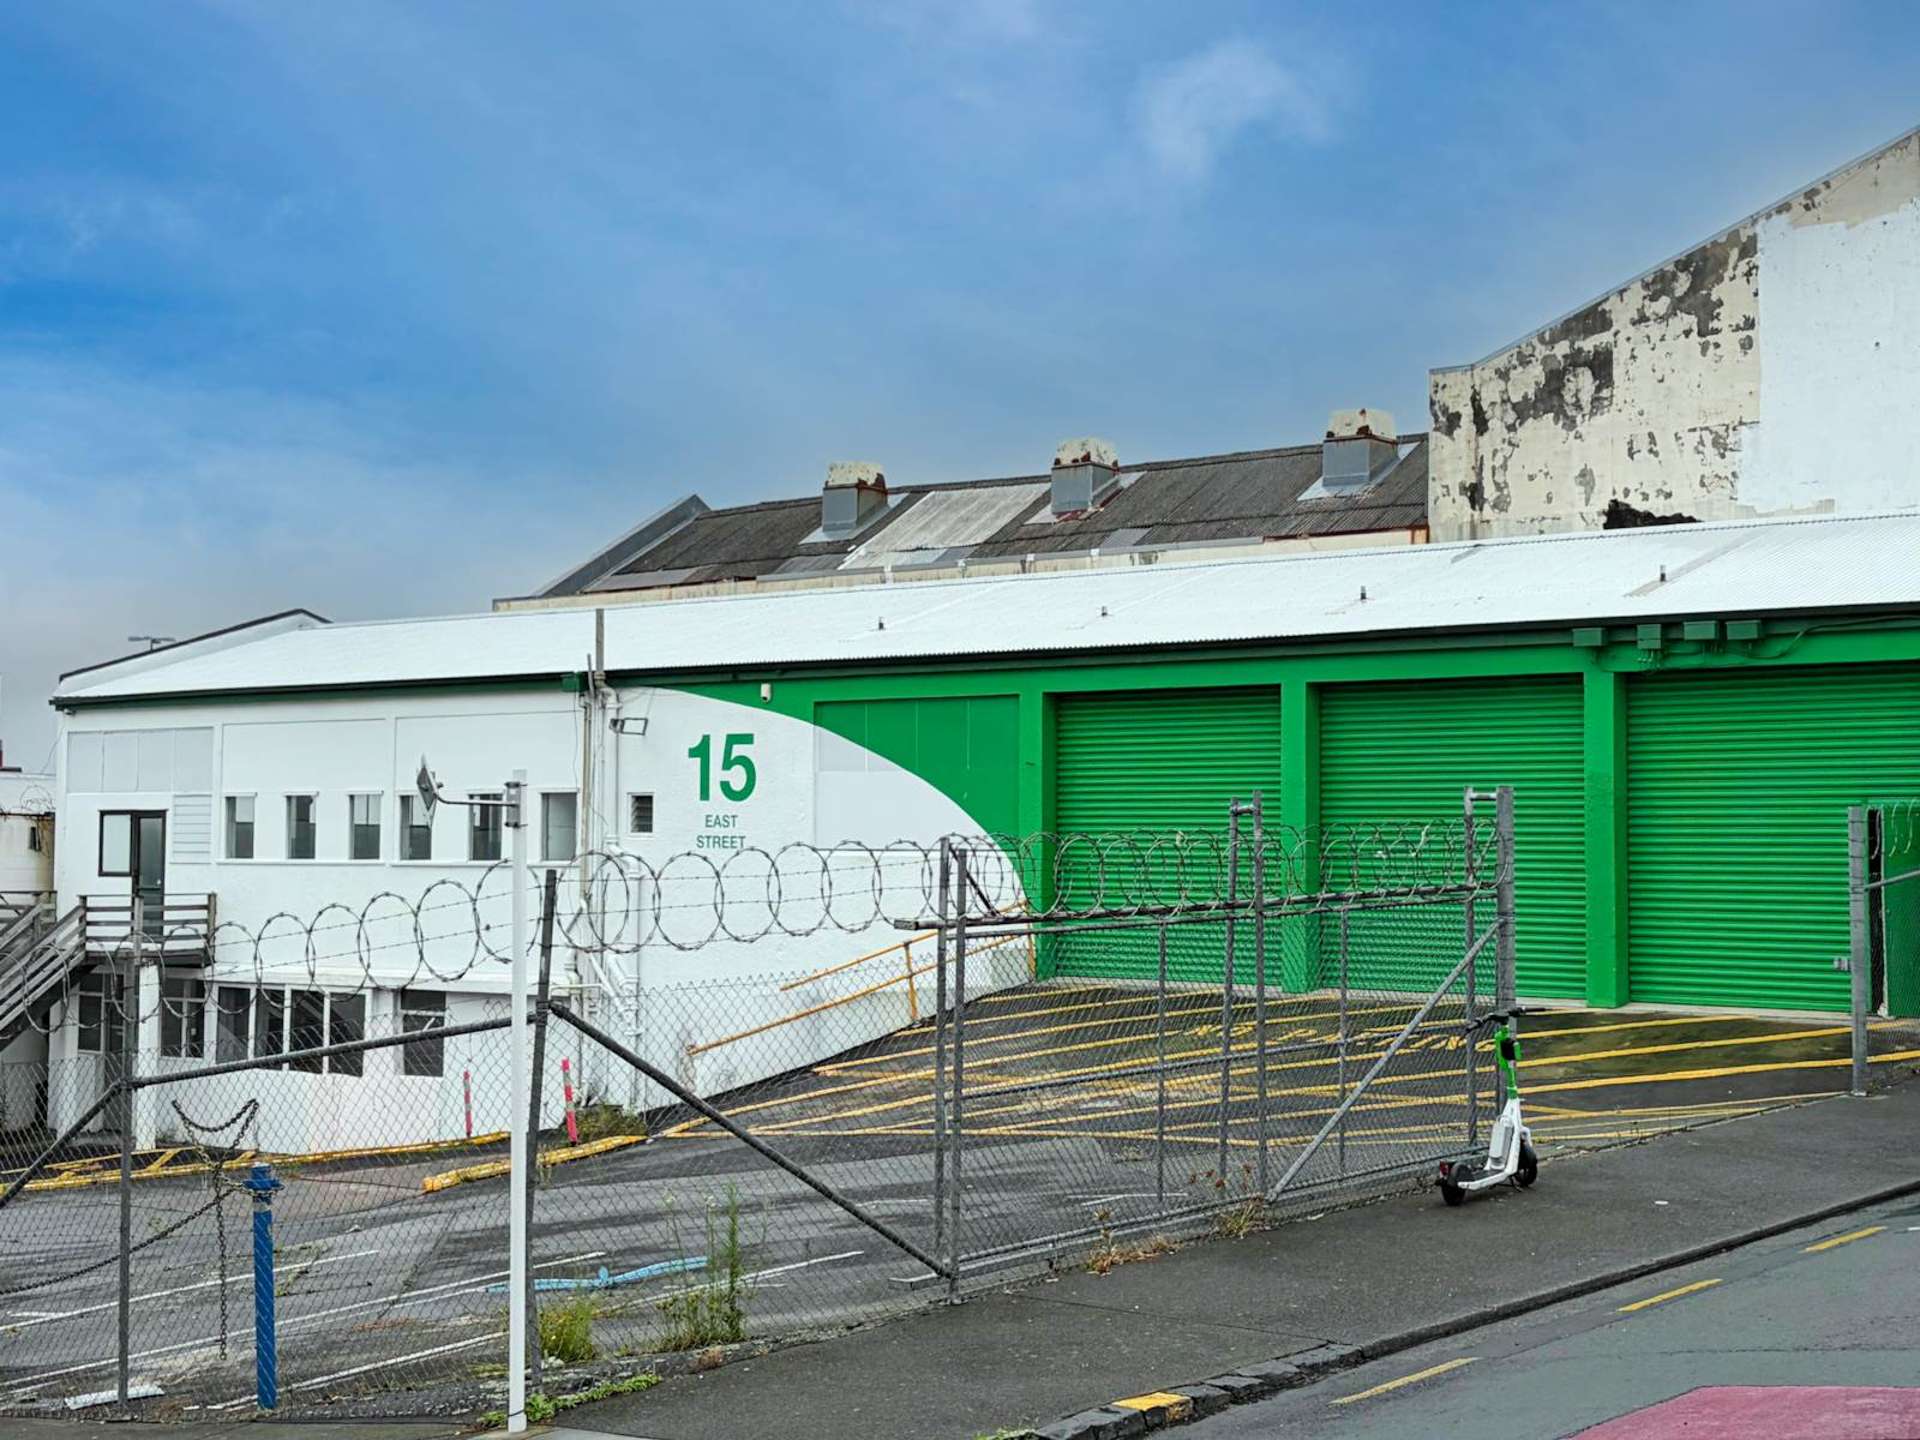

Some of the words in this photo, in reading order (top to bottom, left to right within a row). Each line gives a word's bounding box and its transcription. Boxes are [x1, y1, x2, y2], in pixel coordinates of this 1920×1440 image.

[688, 733, 757, 801] 15
[705, 814, 738, 828] EAST
[696, 835, 746, 849] STREET
